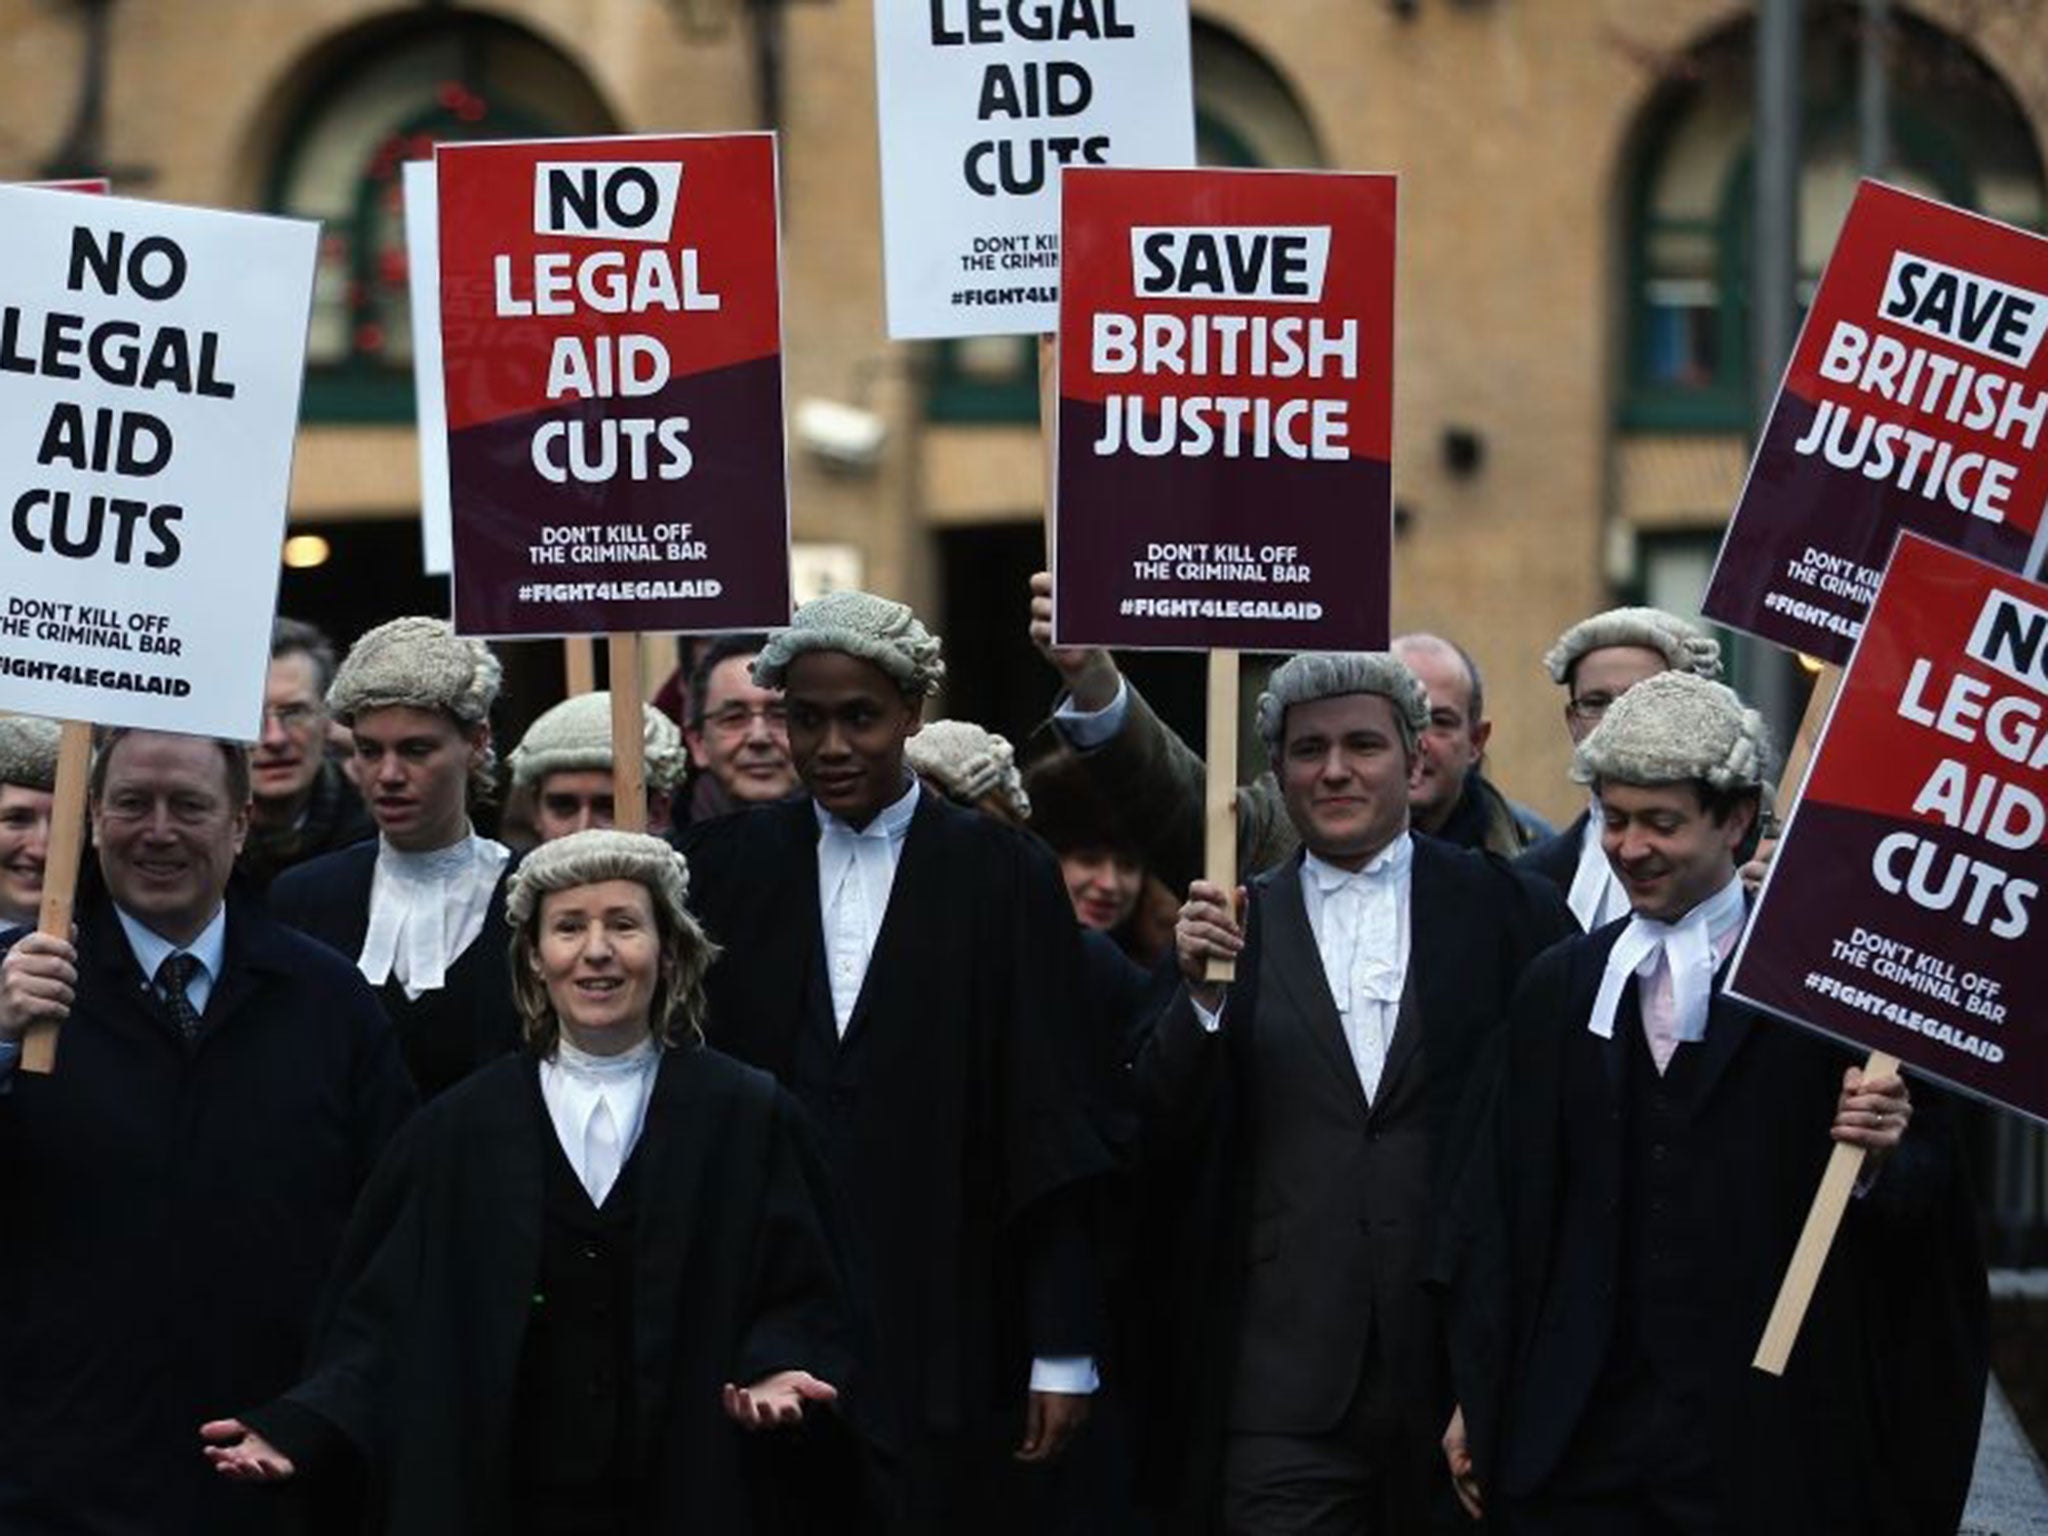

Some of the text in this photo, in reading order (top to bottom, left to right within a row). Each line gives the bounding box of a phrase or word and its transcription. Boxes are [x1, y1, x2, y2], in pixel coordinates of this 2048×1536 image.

[930, 0, 1135, 46] LEGAL
[978, 61, 1092, 120] AID
[549, 167, 659, 230] NO
[67, 226, 187, 301] NO
[961, 252, 1058, 270] THE CRIMIN
[973, 235, 1057, 253] DON'T KI
[1144, 233, 1309, 295] SAVE
[495, 249, 720, 316] LEGAL
[952, 287, 1058, 305] #FIGHT4LE
[1886, 262, 2034, 358] SAVE
[0, 307, 235, 399] LEGAL
[546, 334, 670, 398] AID
[1092, 313, 1357, 378] BRITISH
[1819, 321, 2048, 449] BRITISH
[37, 402, 173, 477] AID
[532, 417, 692, 482] CUTS
[1094, 395, 1349, 460] JUSTICE
[1795, 399, 2018, 523] JUSTICE
[12, 489, 183, 568] CUTS
[529, 542, 707, 563] THE CRIMINAL BAR
[542, 523, 692, 545] DON'T KILL OFF
[1148, 544, 1297, 563] DON'T KILL OFF
[519, 580, 722, 602] #FIGHT4LEGALAID
[1133, 561, 1310, 582] THE CRIMINAL BAR
[1788, 560, 1875, 604] THE CRIMIN
[1803, 547, 1881, 589] DON'T KIL
[0, 616, 181, 656] HE CRIMINAL BAR
[9, 597, 169, 634] DON'T KILL OFF
[1121, 599, 1322, 620] #FIGHT4LEGALAID
[1765, 592, 1862, 640] #FIGHT4LE
[1982, 601, 2048, 679] N
[0, 656, 191, 697] IGHT4LEGALAID
[1897, 658, 2048, 770] LEG
[1912, 759, 2045, 849] AID
[1873, 833, 2038, 938] CUTS
[1832, 940, 2006, 1024] THE CRIMINAL BAR
[1850, 928, 2001, 998] DON'T KILL OFF
[1805, 973, 2003, 1062] #FIGHT4LEGALAID
